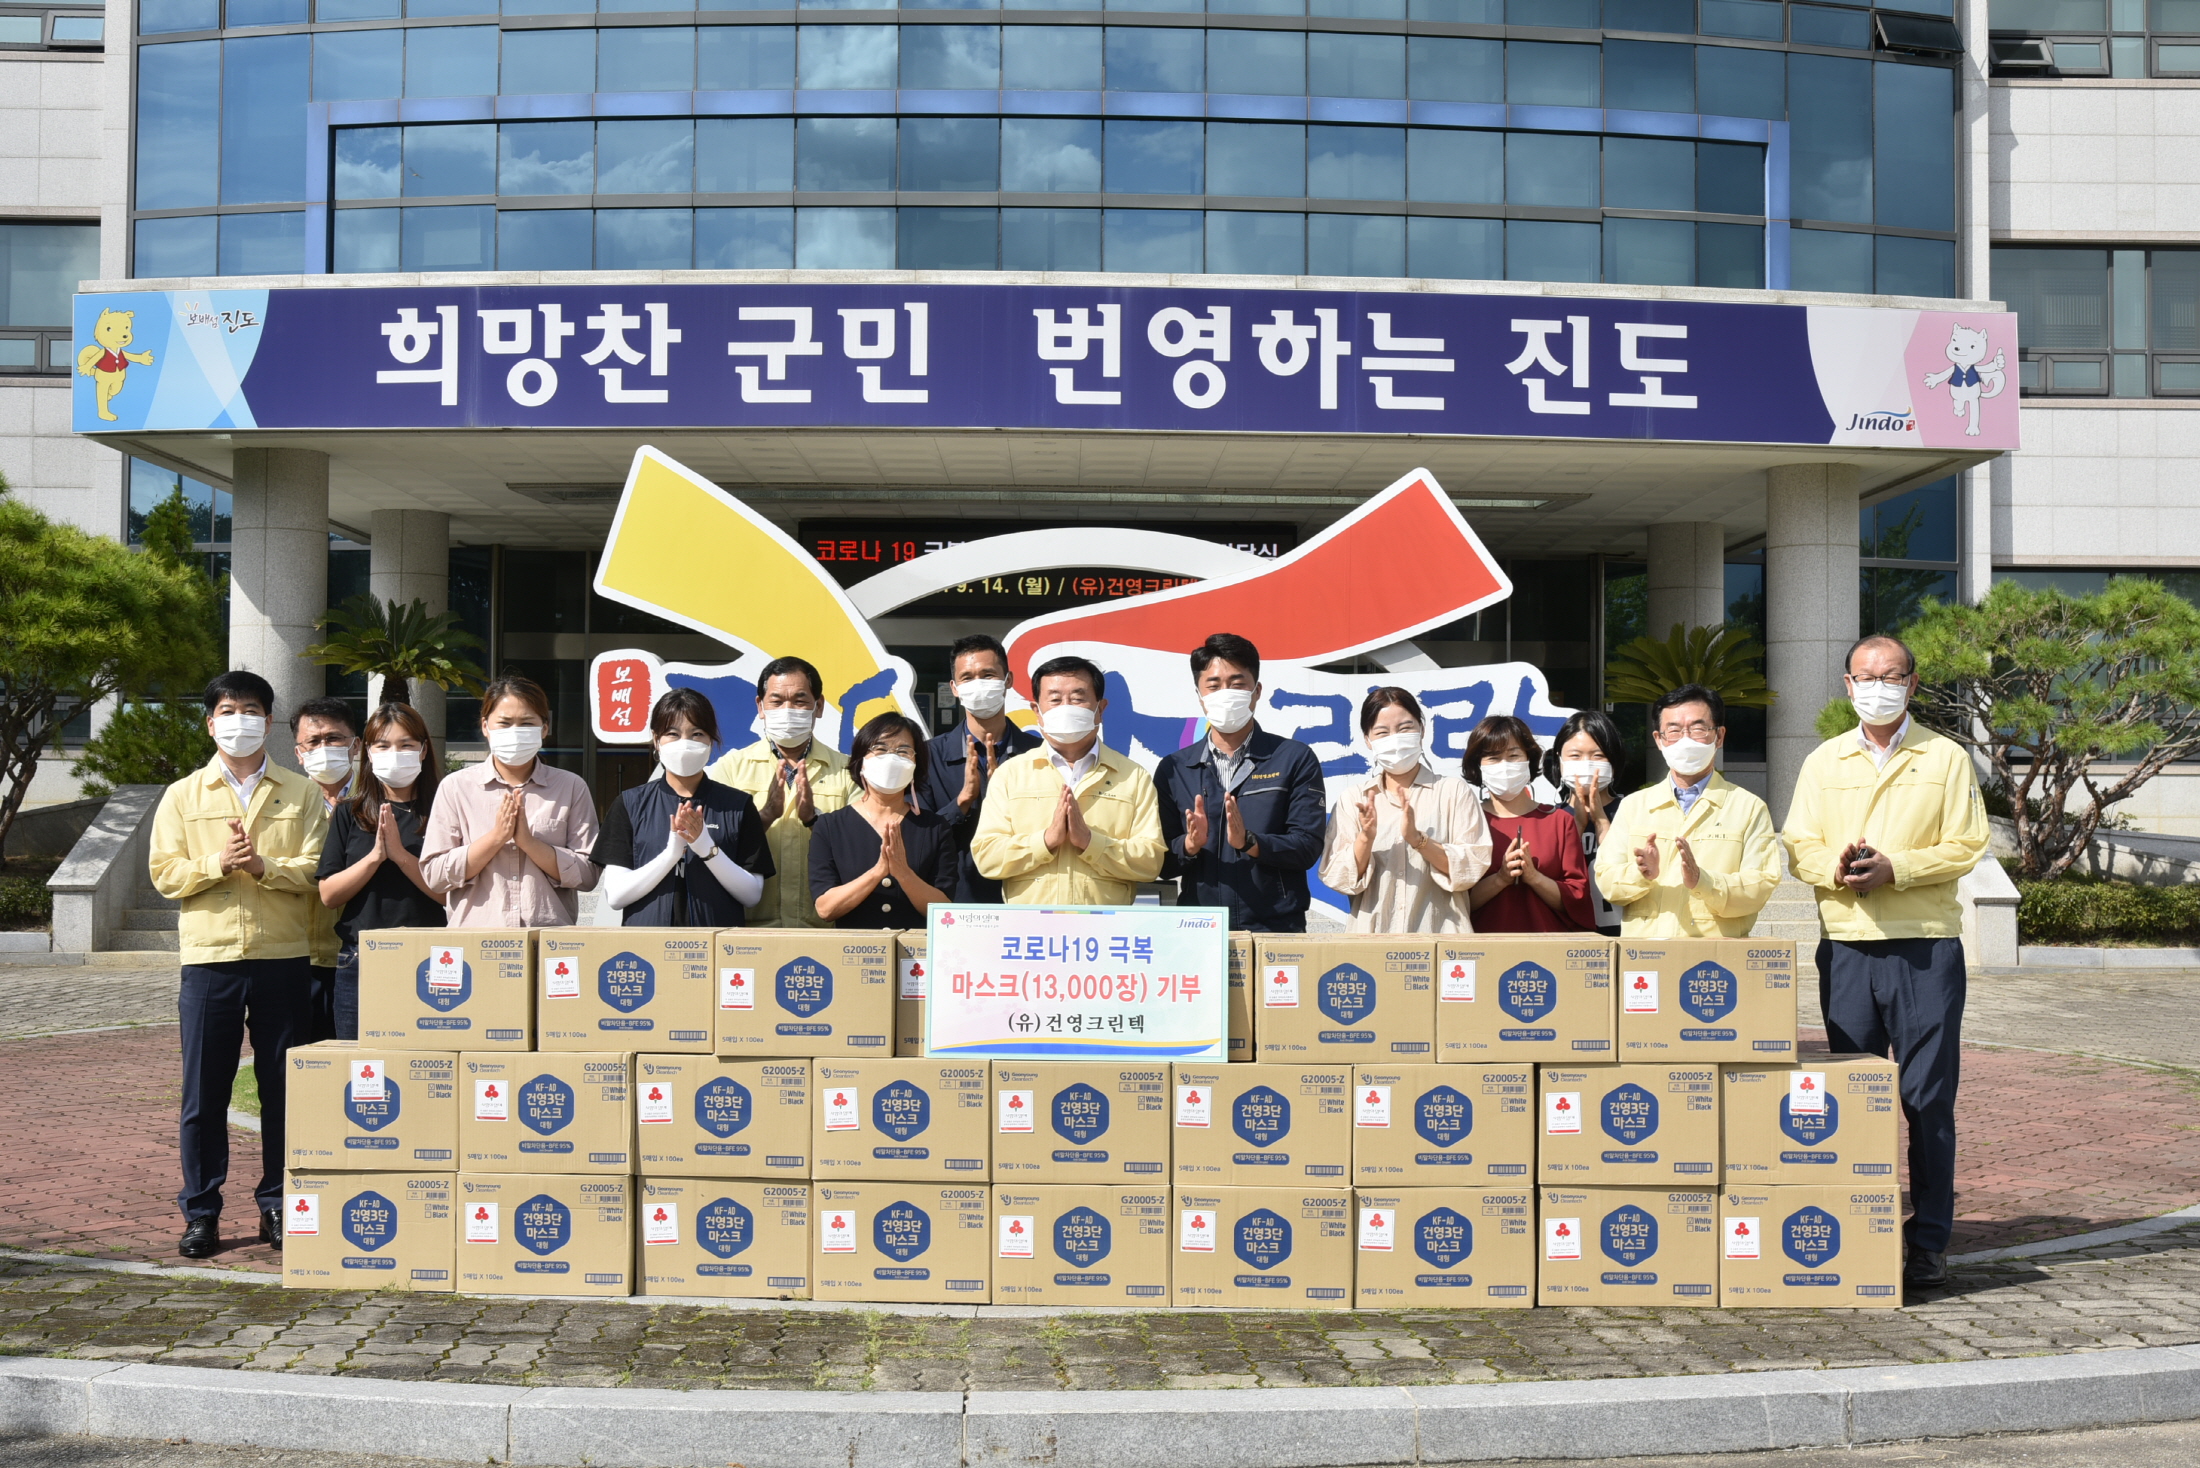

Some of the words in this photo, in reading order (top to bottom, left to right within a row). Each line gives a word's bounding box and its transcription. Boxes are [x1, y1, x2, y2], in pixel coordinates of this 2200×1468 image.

[187, 313, 218, 328] 보배섬
[221, 310, 260, 333] 진도
[376, 302, 681, 407] 희망찬
[728, 302, 928, 403] 군민
[1033, 303, 1455, 410] 번영하는
[1504, 315, 1698, 415] 진도
[1845, 413, 1904, 431] Jindo
[816, 540, 881, 562] 코로나
[891, 541, 916, 561] 19
[982, 578, 1009, 594] 14.
[1018, 577, 1050, 595] (월)
[611, 666, 634, 727] 보배섬
[1177, 918, 1209, 928] Jindo
[481, 939, 523, 948] G20005-Z
[665, 940, 707, 949] G20005-Z
[843, 945, 886, 954] G20005-Z
[1000, 935, 1099, 963] 코로나19
[1108, 936, 1154, 964] 극복
[1386, 951, 1430, 960] G20005-Z
[1747, 949, 1791, 958] G20005-Z
[616, 961, 637, 969] KF-AD
[793, 965, 815, 974] KF-AD
[607, 970, 646, 984] 건영3단
[1336, 972, 1358, 981] KF-AD
[1517, 970, 1538, 979] KF-AD
[1697, 970, 1719, 979] KF-AD
[784, 975, 824, 988] 건영3단
[952, 971, 1148, 1003] 마스크(13,000장)
[1156, 974, 1201, 1003] 기부
[1507, 980, 1548, 994] 건영3단
[1688, 980, 1729, 993] 건영3단
[610, 985, 643, 997] 마스크
[1327, 982, 1367, 996] 건영3단
[788, 990, 821, 1002] 마스크
[1511, 994, 1544, 1007] 마스크
[1692, 994, 1725, 1007] 마스크
[1330, 996, 1364, 1009] 마스크
[1008, 1012, 1145, 1034] (유)건영크린텍
[410, 1060, 452, 1068] G20005-Z
[584, 1063, 626, 1072] G20005-Z
[762, 1066, 805, 1075] G20005-Z
[940, 1069, 983, 1078] G20005-Z
[1120, 1072, 1163, 1080] G20005-Z
[1669, 1071, 1712, 1080] G20005-Z
[1301, 1075, 1344, 1083] G20005-Z
[1483, 1074, 1527, 1083] G20005-Z
[1849, 1073, 1892, 1082] G20005-Z
[536, 1083, 557, 1092] KF-AD
[713, 1085, 734, 1094] KF-AD
[891, 1089, 912, 1097] KF-AD
[527, 1093, 566, 1106] 건영3단
[704, 1095, 743, 1109] 건영3단
[1070, 1092, 1091, 1101] KF-AD
[1251, 1095, 1272, 1103] KF-AD
[1432, 1094, 1454, 1103] KF-AD
[1619, 1092, 1641, 1101] KF-AD
[356, 1103, 388, 1116] 마스크
[881, 1099, 922, 1112] 건영3단
[1060, 1102, 1101, 1115] 건영3단
[1241, 1105, 1282, 1118] 건영3단
[1422, 1104, 1464, 1117] 건영3단
[1609, 1102, 1650, 1115] 건영3단
[530, 1107, 563, 1119] 마스크
[707, 1110, 740, 1122] 마스크
[885, 1113, 918, 1125] 마스크
[1064, 1116, 1097, 1129] 마스크
[1245, 1119, 1278, 1131] 마스크
[1426, 1118, 1460, 1131] 마스크
[1613, 1116, 1647, 1129] 마스크
[1792, 1117, 1826, 1130] 마스크
[407, 1180, 449, 1189] G20005-Z
[581, 1184, 623, 1192] G20005-Z
[764, 1187, 806, 1196] G20005-Z
[941, 1190, 984, 1198] G20005-Z
[1668, 1193, 1712, 1202] G20005-Z
[359, 1199, 380, 1208] KF-AD
[1121, 1195, 1165, 1204] G20005-Z
[1303, 1198, 1346, 1207] G20005-Z
[1483, 1195, 1526, 1204] G20005-Z
[1850, 1194, 1894, 1203] G20005-Z
[532, 1203, 553, 1212] KF-AD
[714, 1206, 736, 1215] KF-AD
[350, 1209, 389, 1222] 건영3단
[523, 1213, 562, 1226] 건영3단
[891, 1210, 913, 1218] KF-AD
[1071, 1215, 1093, 1224] KF-AD
[1619, 1214, 1640, 1222] KF-AD
[1800, 1215, 1822, 1224] KF-AD
[705, 1216, 745, 1229] 건영3단
[882, 1220, 922, 1233] 건영3단
[1252, 1217, 1274, 1226] KF-AD
[1433, 1216, 1454, 1225] KF-AD
[353, 1223, 385, 1236] 마스크
[526, 1227, 559, 1240] 마스크
[1062, 1225, 1103, 1238] 건영3단
[1243, 1227, 1283, 1240] 건영3단
[1423, 1226, 1464, 1240] 건영3단
[1609, 1224, 1650, 1237] 건영3단
[1791, 1225, 1832, 1238] 건영3단
[708, 1230, 741, 1243] 마스크
[886, 1234, 919, 1246] 마스크
[1066, 1239, 1099, 1252] 마스크
[1246, 1242, 1280, 1254] 마스크
[1427, 1240, 1461, 1253] 마스크
[1613, 1238, 1646, 1251] 마스크
[1795, 1239, 1828, 1252] 마스크
